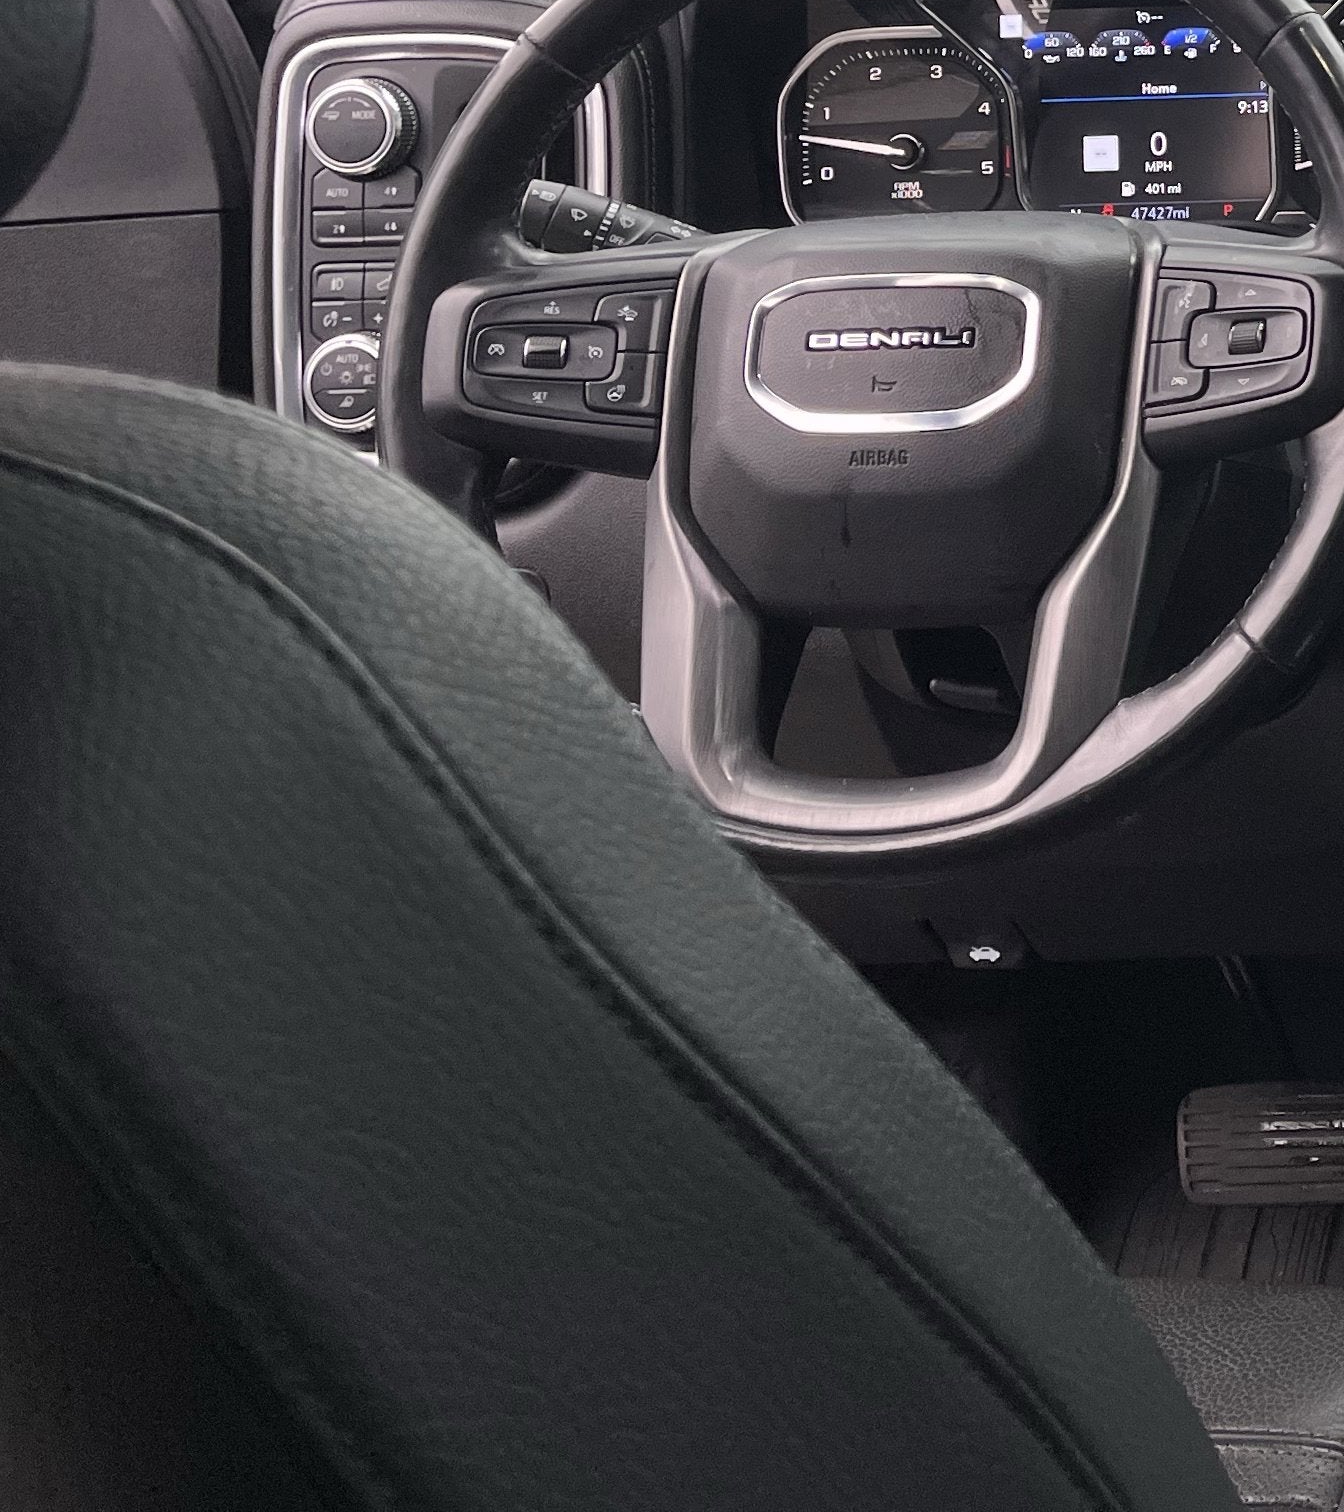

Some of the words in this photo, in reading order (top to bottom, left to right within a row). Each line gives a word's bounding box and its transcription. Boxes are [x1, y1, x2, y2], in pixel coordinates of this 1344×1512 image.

[869, 67, 882, 81] 2
[930, 65, 943, 79] 3
[1141, 83, 1177, 94] Home
[823, 106, 831, 121] 1
[978, 102, 991, 116] 4
[1237, 100, 1269, 114] 9:13
[1150, 131, 1168, 157] 0
[820, 166, 834, 181] 0
[981, 161, 994, 175] 5
[1144, 160, 1173, 175] MPH
[326, 188, 349, 198] AUTO
[1145, 183, 1165, 194] 401
[1223, 204, 1234, 217] P
[806, 327, 974, 351] DENALI
[336, 354, 359, 364] AUTO
[849, 449, 909, 466] AIRBAG
